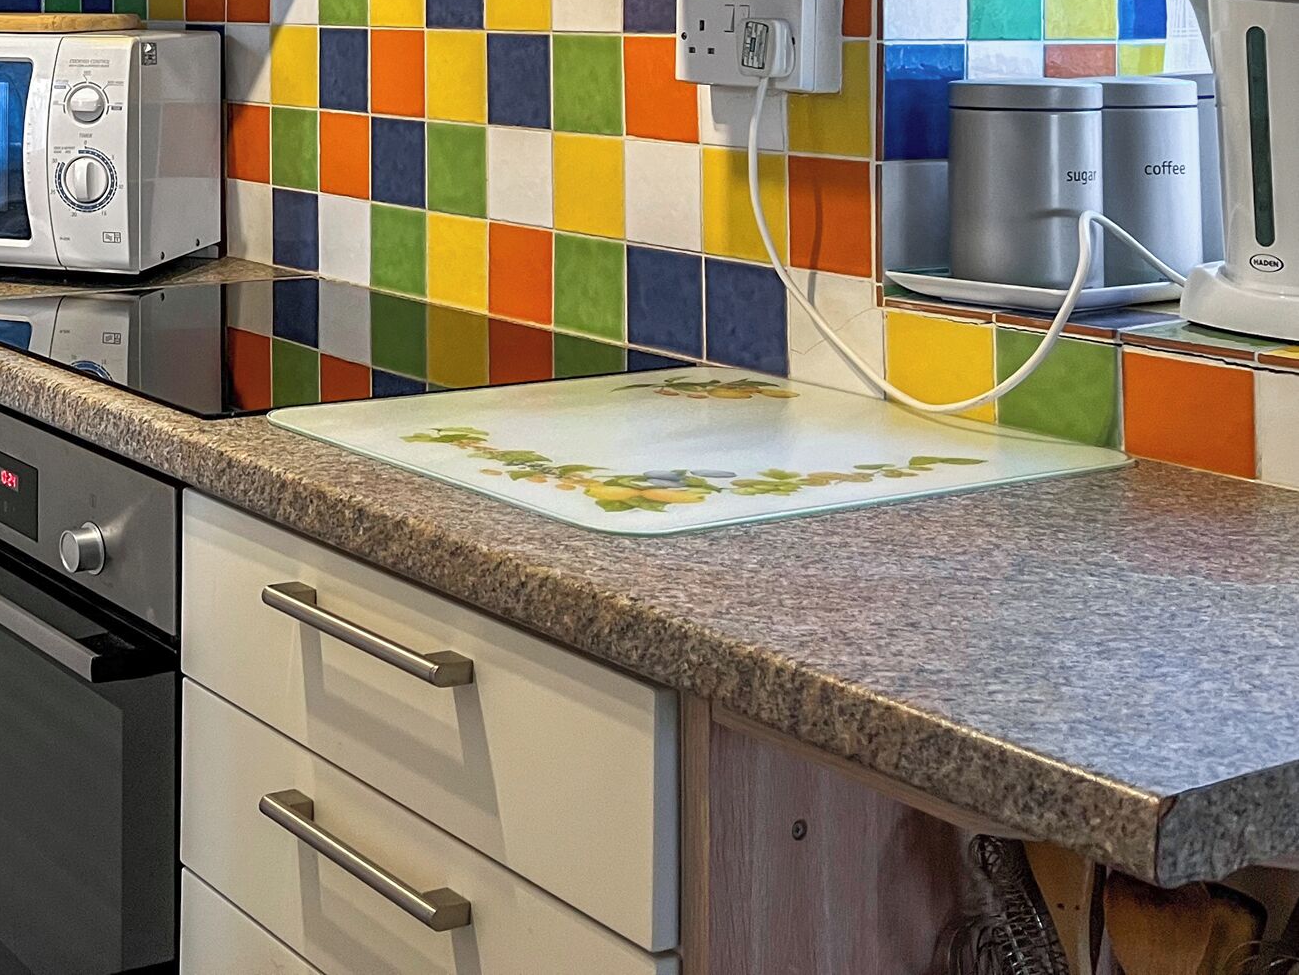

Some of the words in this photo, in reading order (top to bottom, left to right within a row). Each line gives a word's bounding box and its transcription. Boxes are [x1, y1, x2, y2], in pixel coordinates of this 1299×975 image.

[1144, 160, 1186, 176] coffee
[1066, 170, 1097, 185] sugar
[1253, 258, 1280, 268] HADEN
